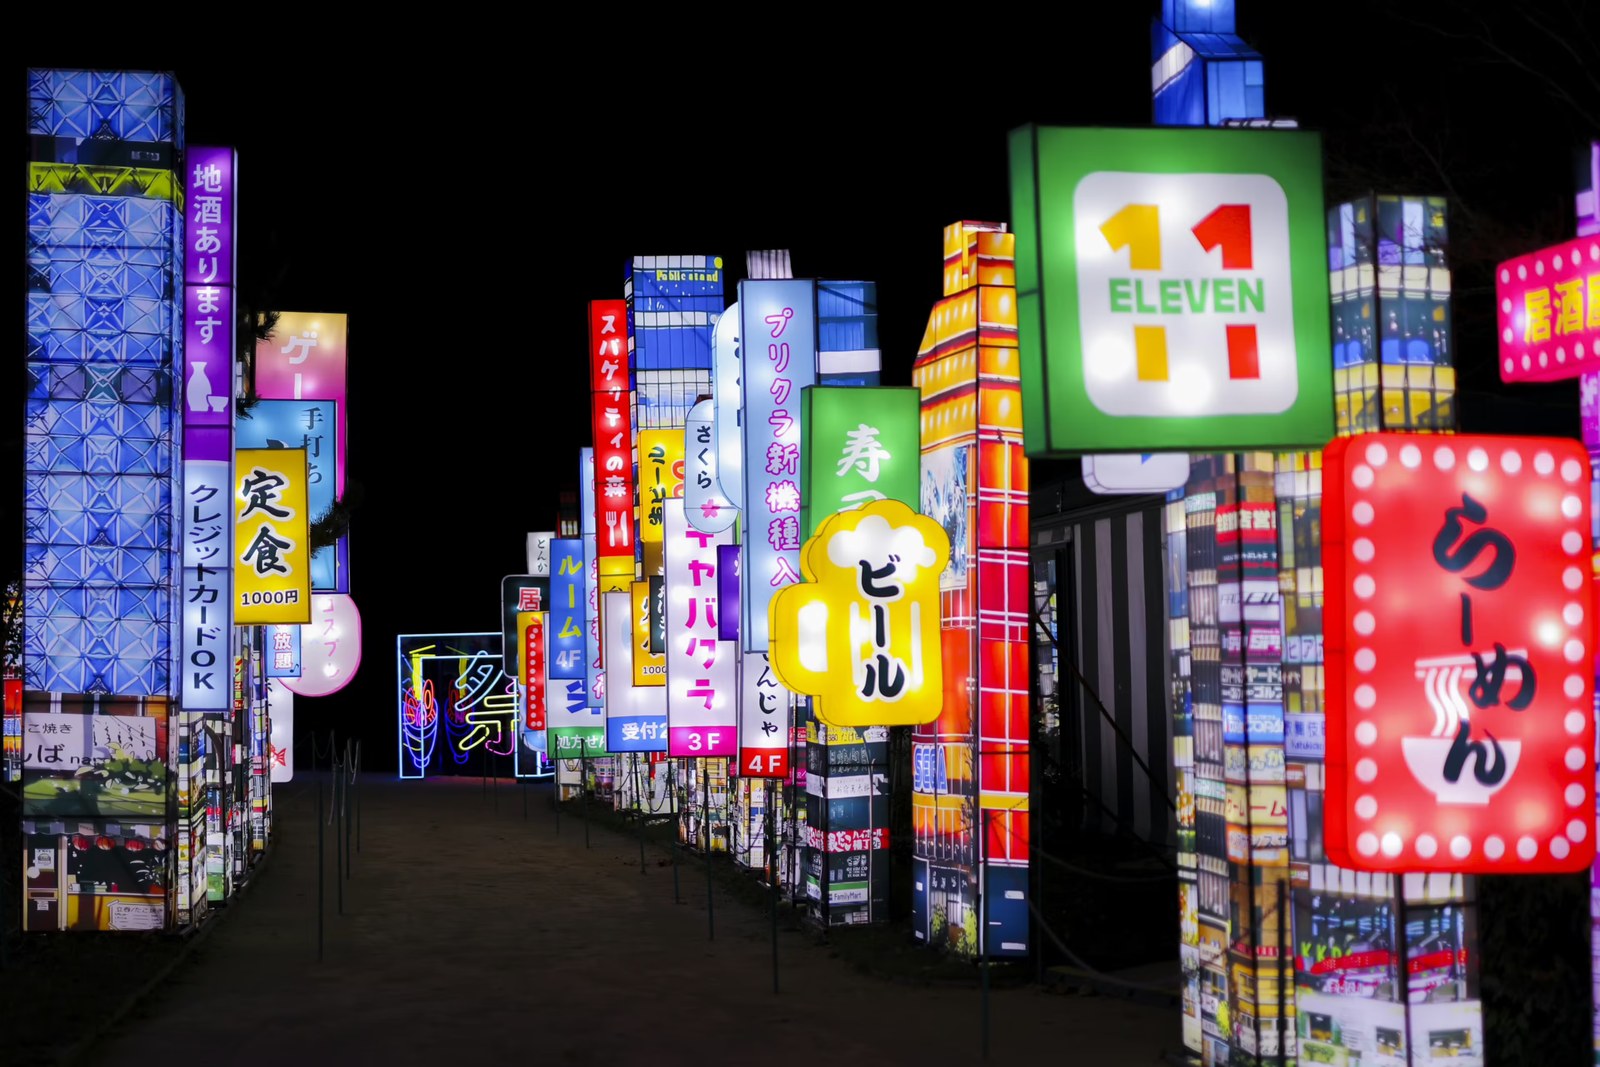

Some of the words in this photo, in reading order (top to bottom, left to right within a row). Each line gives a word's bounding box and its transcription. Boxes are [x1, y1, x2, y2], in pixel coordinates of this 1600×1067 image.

[193, 164, 222, 345] 地酒あります
[1109, 277, 1265, 313] ELEVEN
[301, 407, 323, 484] 手打ち
[697, 426, 712, 489] さくら
[765, 307, 800, 587] プリクラ新機種入
[241, 470, 291, 574] 定食
[189, 485, 222, 690] クレジットカードOK
[241, 589, 298, 606] 1000円
[517, 587, 541, 610] 居
[558, 555, 582, 638] ルーム
[274, 624, 293, 669] 放題
[556, 650, 581, 668] 4F
[859, 554, 905, 698] ビール
[1433, 492, 1537, 787] らーめん
[757, 654, 779, 738] んじゃ
[688, 732, 721, 751] 3F
[749, 755, 781, 773] 4F
[914, 745, 948, 794] SEGA
